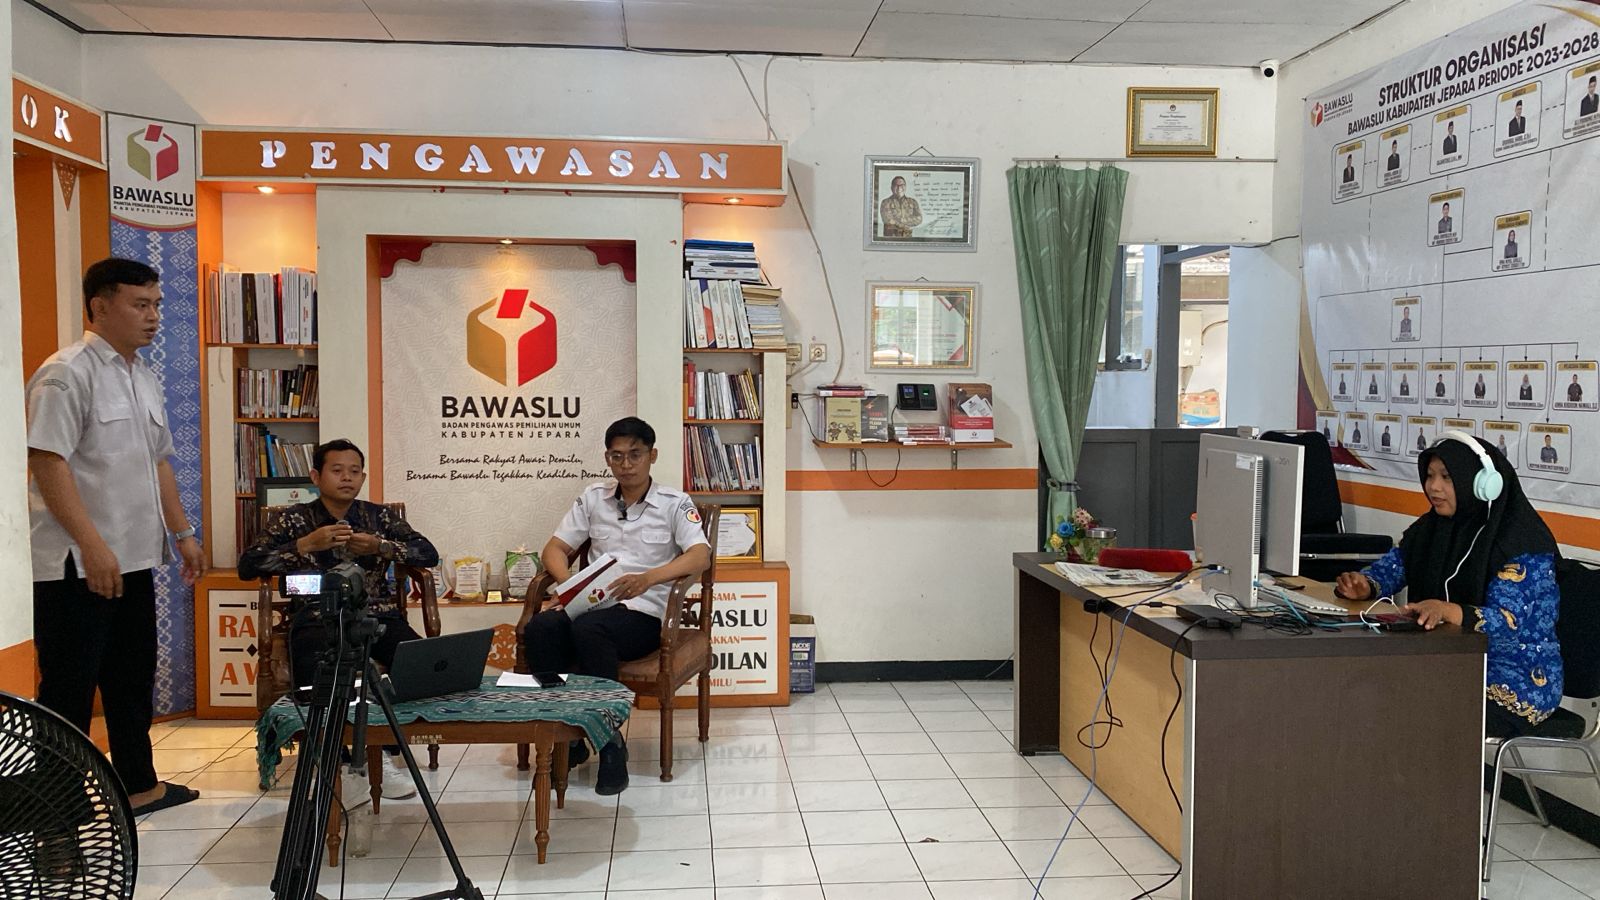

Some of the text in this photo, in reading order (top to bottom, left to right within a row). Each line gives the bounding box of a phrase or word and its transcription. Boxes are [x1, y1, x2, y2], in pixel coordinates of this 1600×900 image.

[1379, 23, 1546, 107] STRUKTUR ORGANISASI
[1347, 109, 1385, 136] BAWASLU
[1386, 94, 1436, 121] KABUPATEN
[1438, 79, 1475, 103] JEPARA
[1478, 65, 1523, 89] PERIODE
[1526, 32, 1600, 73] 2023-2028
[1324, 92, 1353, 113] BAWASLU
[260, 140, 729, 181] PENGAWASAN
[113, 185, 194, 207] BAWASLU
[114, 206, 161, 214] KABUPATEN
[441, 396, 581, 419] BAWASLU
[441, 431, 581, 439] KABUPATEN JEPARA
[439, 454, 480, 465] Bersama
[483, 455, 516, 467] Rakyat
[519, 454, 546, 465] Awasi
[406, 470, 447, 481] Bersama
[450, 469, 490, 481] Bawaslu
[493, 469, 534, 482] Tegakkan
[536, 469, 579, 481] Keadilan
